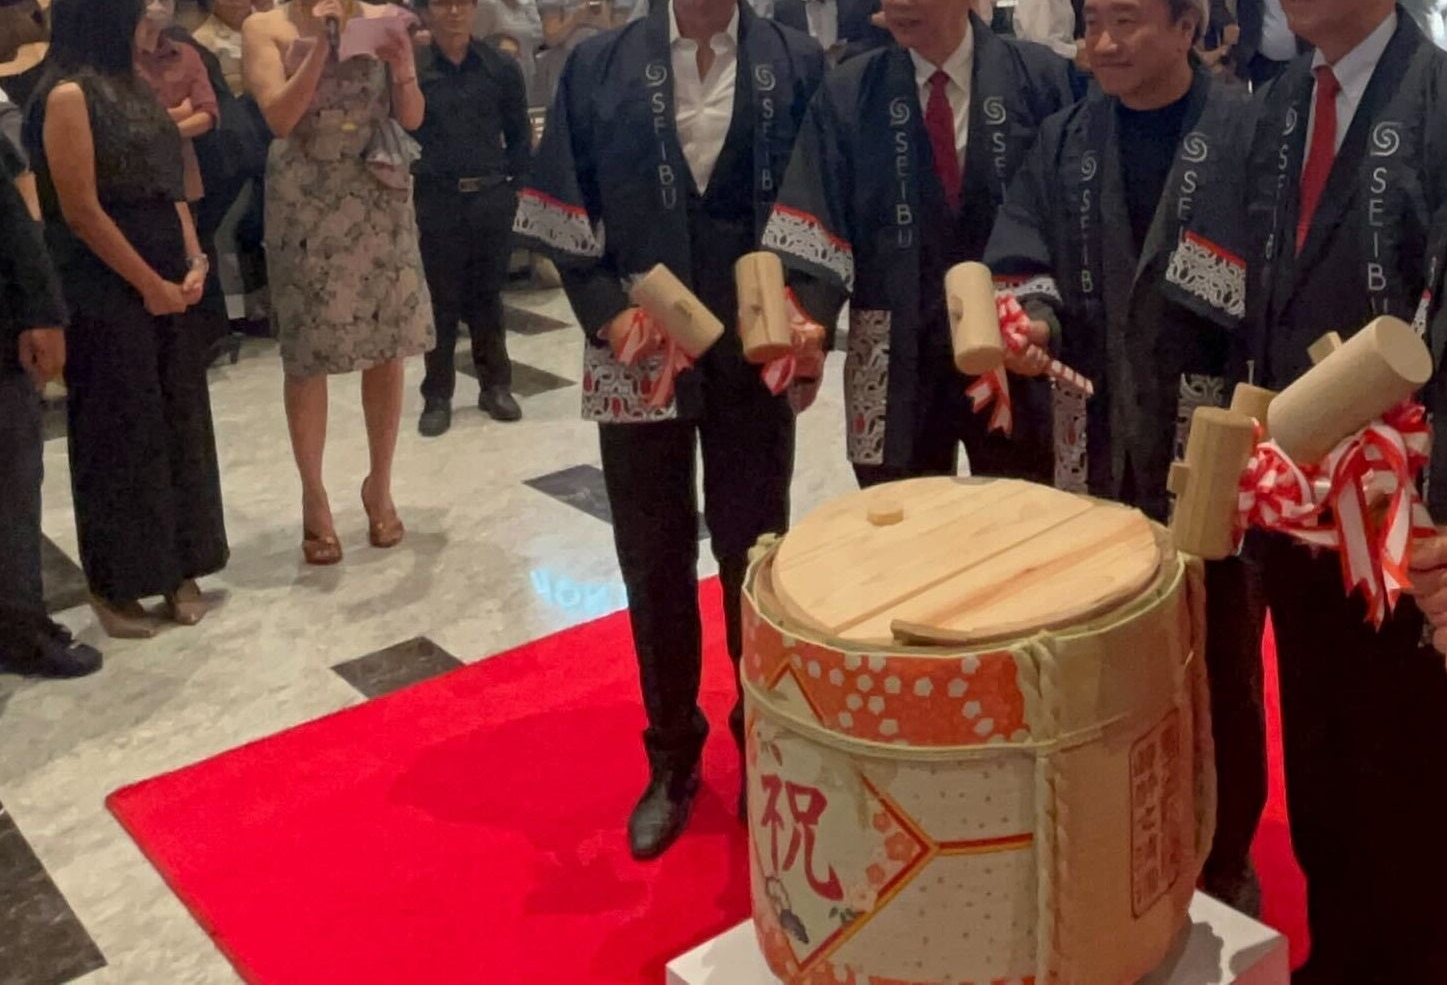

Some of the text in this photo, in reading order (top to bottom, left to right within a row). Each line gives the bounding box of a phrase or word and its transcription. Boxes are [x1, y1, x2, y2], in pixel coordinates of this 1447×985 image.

[651, 92, 677, 210] SEIBU
[895, 132, 913, 249] SEIBU
[761, 773, 845, 901] 祝
